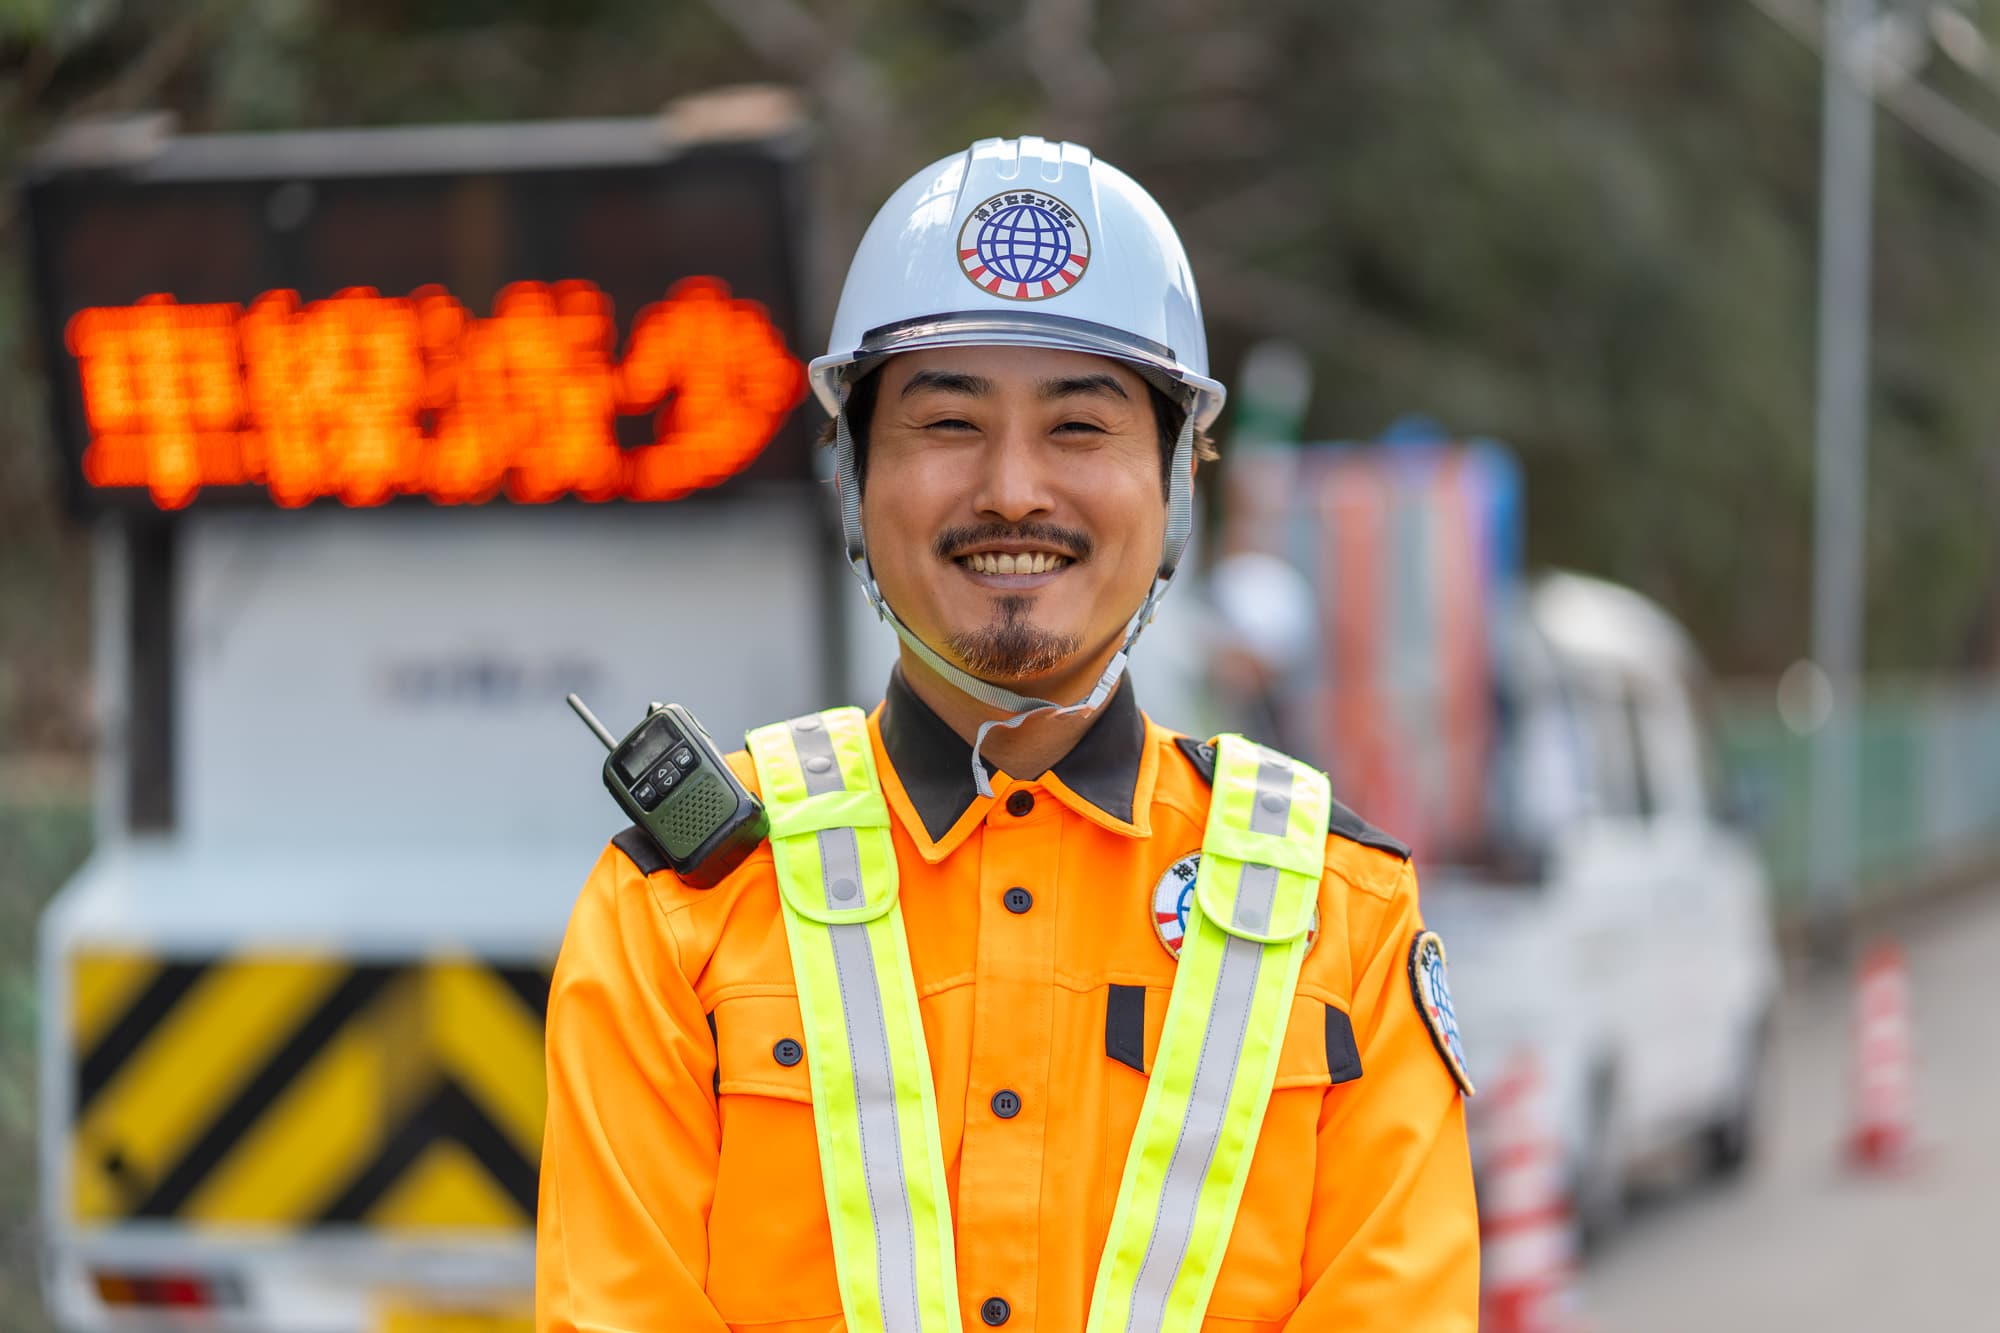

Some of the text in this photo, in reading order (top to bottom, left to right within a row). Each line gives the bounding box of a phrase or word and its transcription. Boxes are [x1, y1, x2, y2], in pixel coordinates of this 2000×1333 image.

[974, 193, 1076, 228] 神戸セキュリティ
